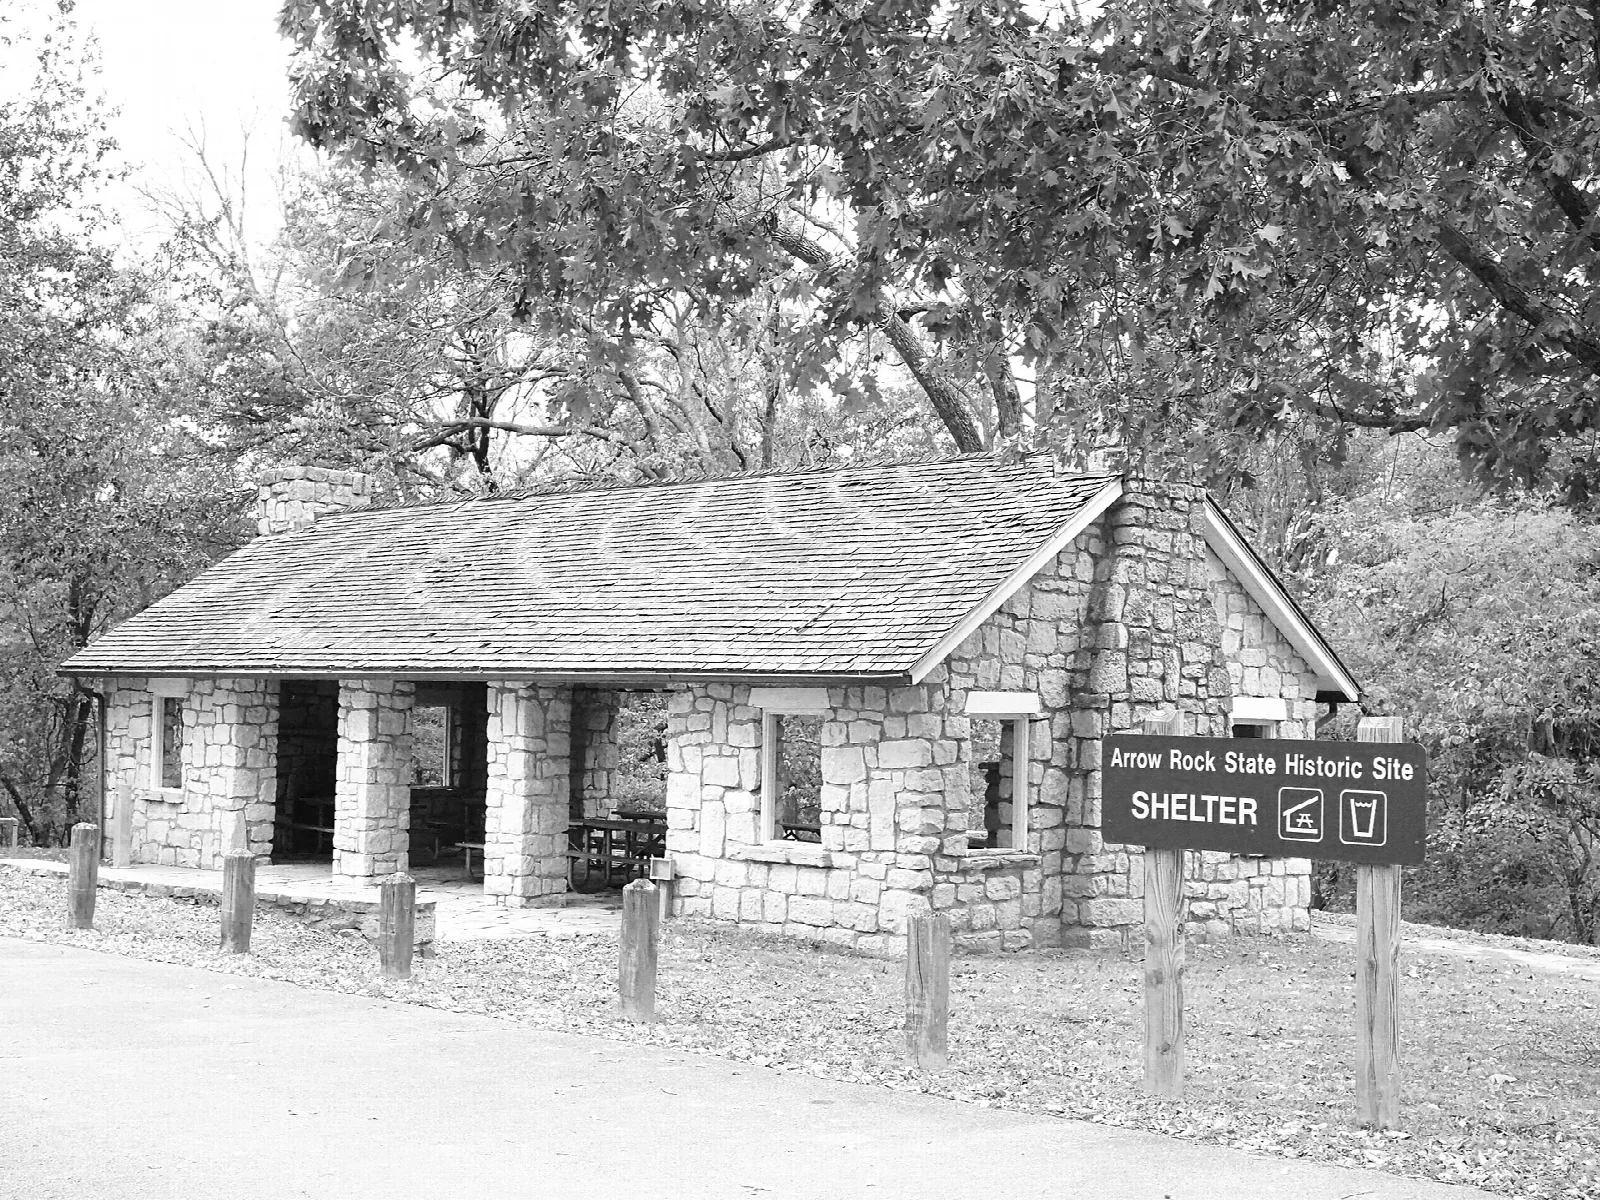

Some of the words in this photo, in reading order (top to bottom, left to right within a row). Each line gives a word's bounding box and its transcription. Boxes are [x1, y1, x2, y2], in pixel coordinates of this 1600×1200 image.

[1110, 747, 1162, 769] Arrow
[1169, 749, 1216, 772] Rock
[1224, 751, 1277, 775] State
[1285, 754, 1363, 779] Historic
[1371, 757, 1414, 781] Site
[1131, 790, 1258, 825] SHELTER
